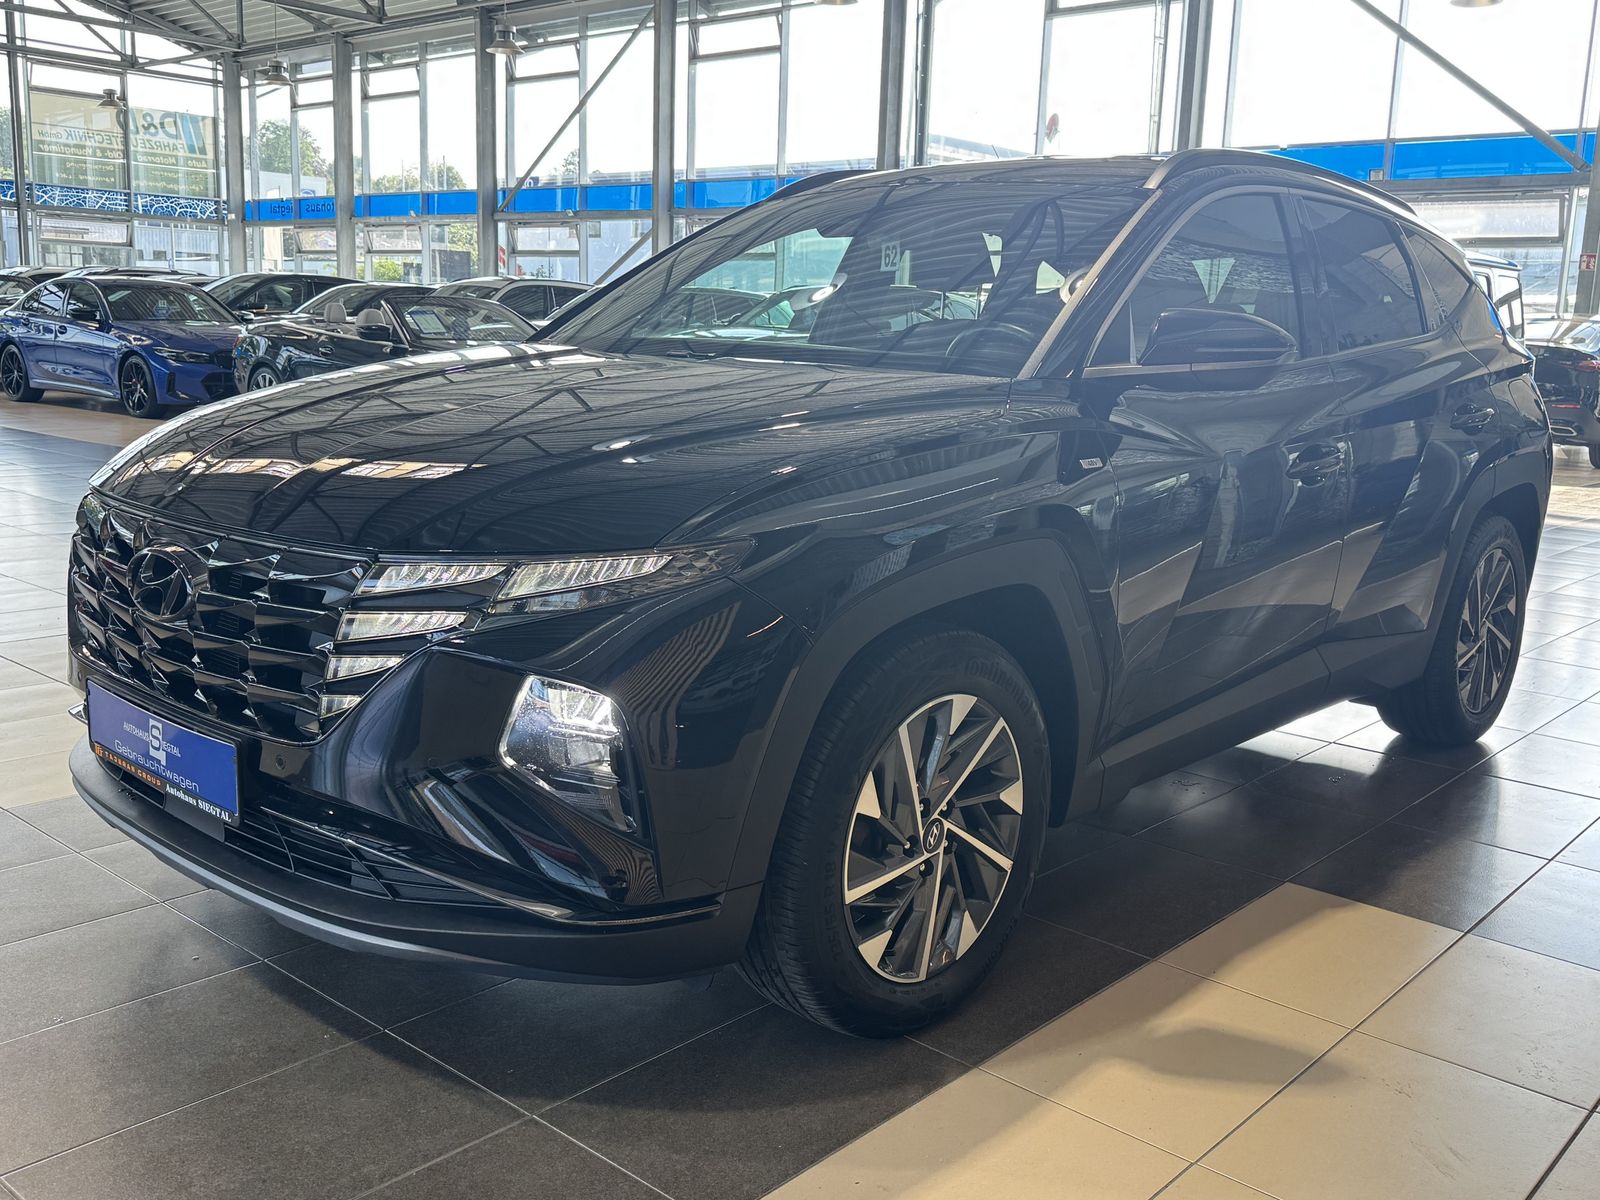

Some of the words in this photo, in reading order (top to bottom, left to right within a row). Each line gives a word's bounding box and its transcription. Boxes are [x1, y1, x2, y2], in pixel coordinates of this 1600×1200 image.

[884, 245, 898, 268] 62
[964, 655, 1032, 717] Continental
[123, 721, 150, 743] AUTOHAUS
[114, 740, 199, 793] Gebrauchtwagen
[137, 769, 161, 786] GROUP
[165, 783, 197, 807] Autohaus
[198, 799, 232, 822] SIEGTAL
